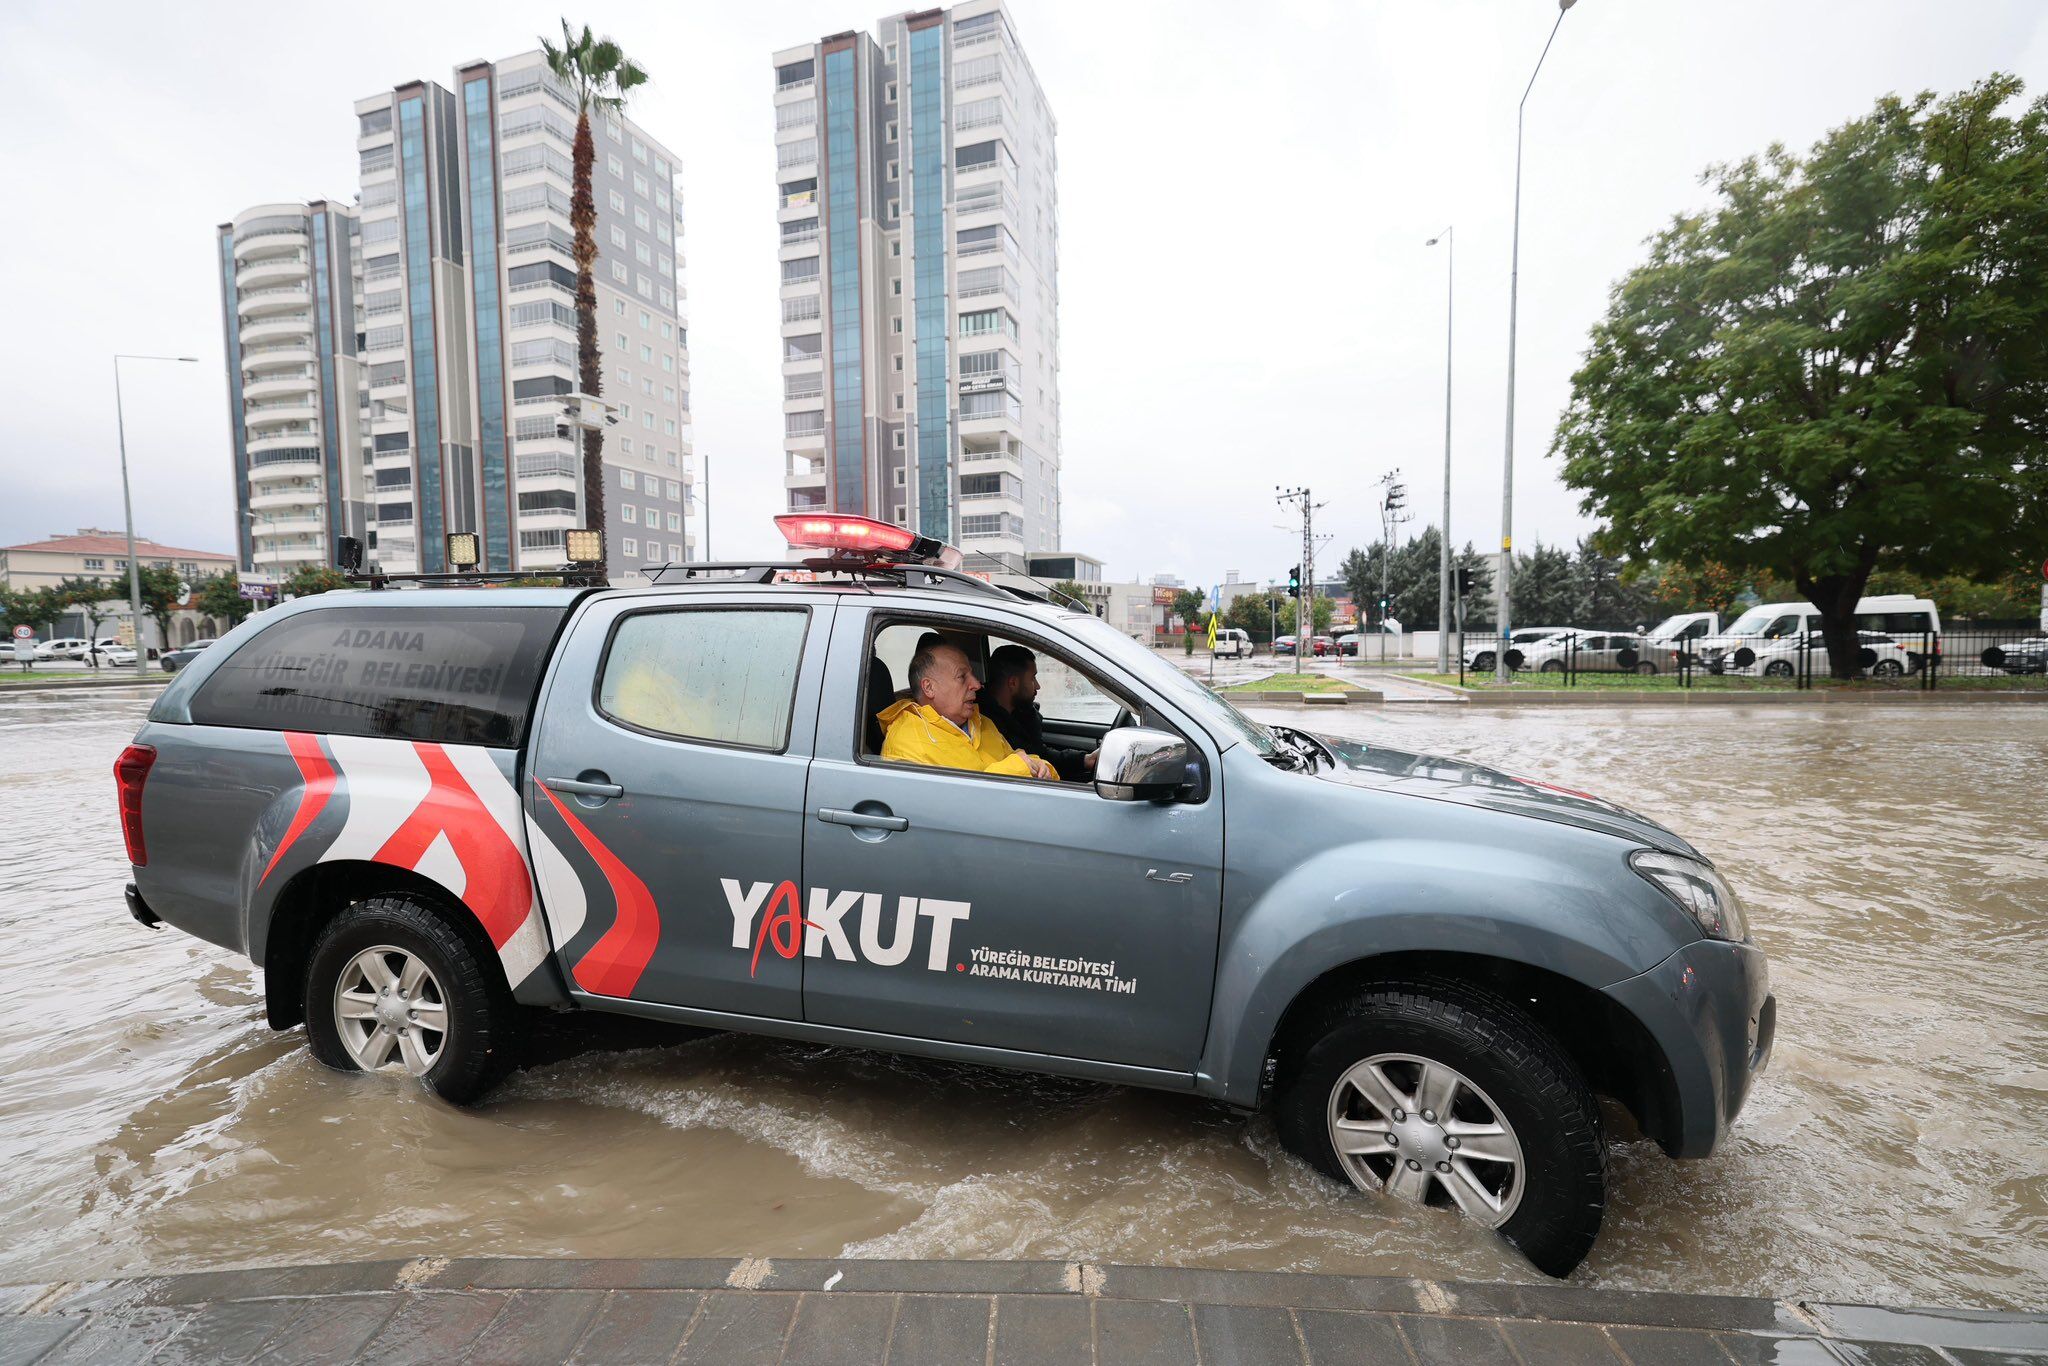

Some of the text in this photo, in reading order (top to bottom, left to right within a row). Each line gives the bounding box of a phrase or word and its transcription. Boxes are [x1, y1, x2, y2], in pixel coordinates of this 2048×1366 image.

[332, 629, 424, 651] ADANA
[250, 651, 503, 695] YÜREĞİR BELEDİYESİ
[970, 946, 1115, 977] YÜREĞİR BELEDİYESİ
[969, 963, 1137, 994] ARAMA KURTARMA TİMİ
